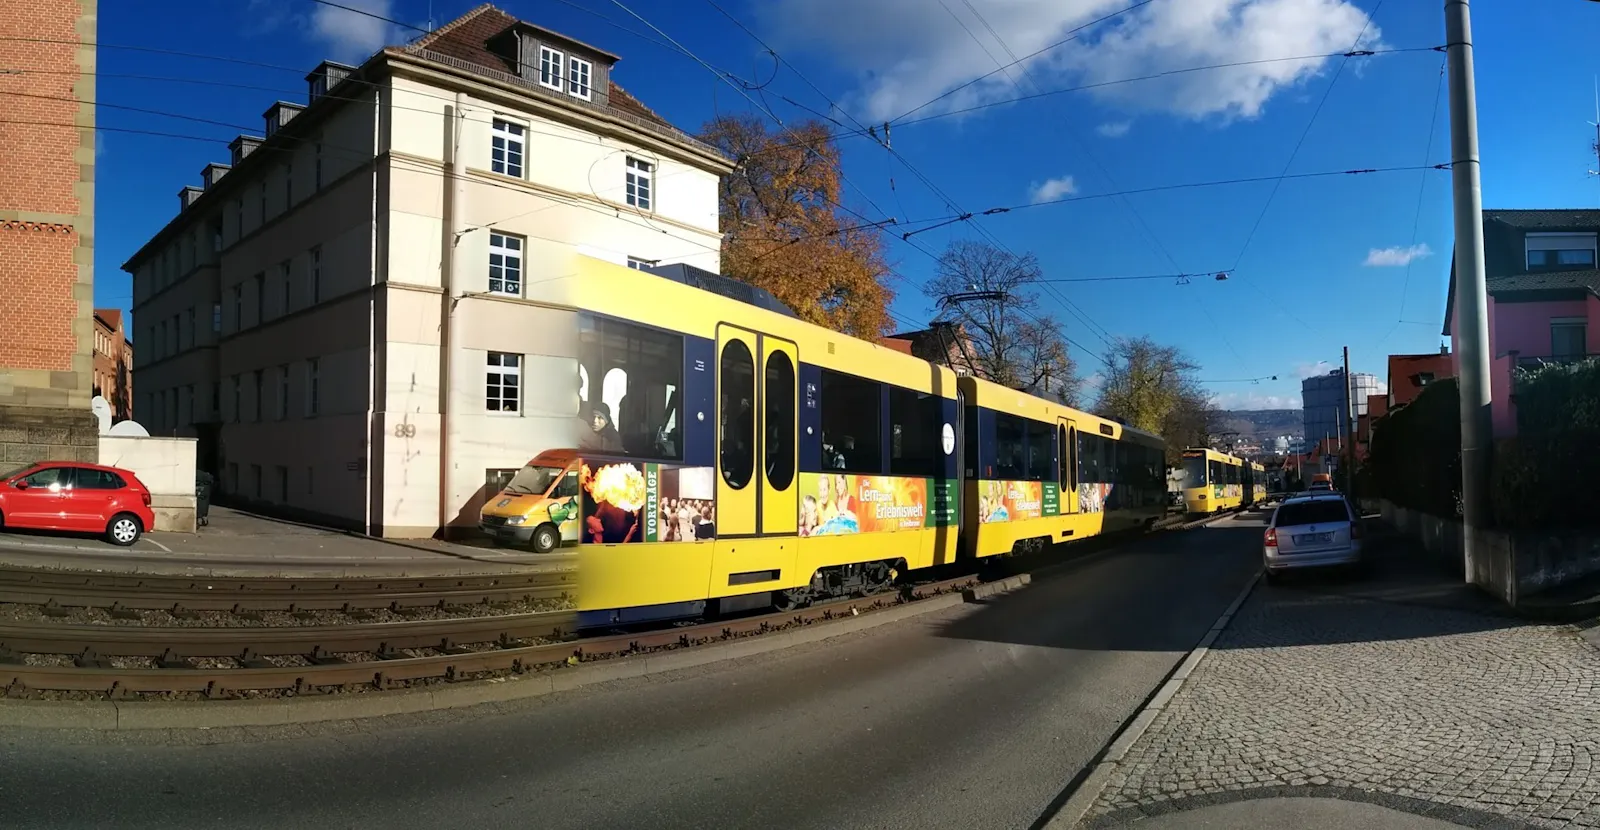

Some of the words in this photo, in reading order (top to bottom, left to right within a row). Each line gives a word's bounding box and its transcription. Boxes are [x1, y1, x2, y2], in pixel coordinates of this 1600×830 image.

[395, 423, 416, 438] 89
[647, 471, 657, 536] VORTRÄGE
[876, 501, 923, 519] Erlebniswelt
